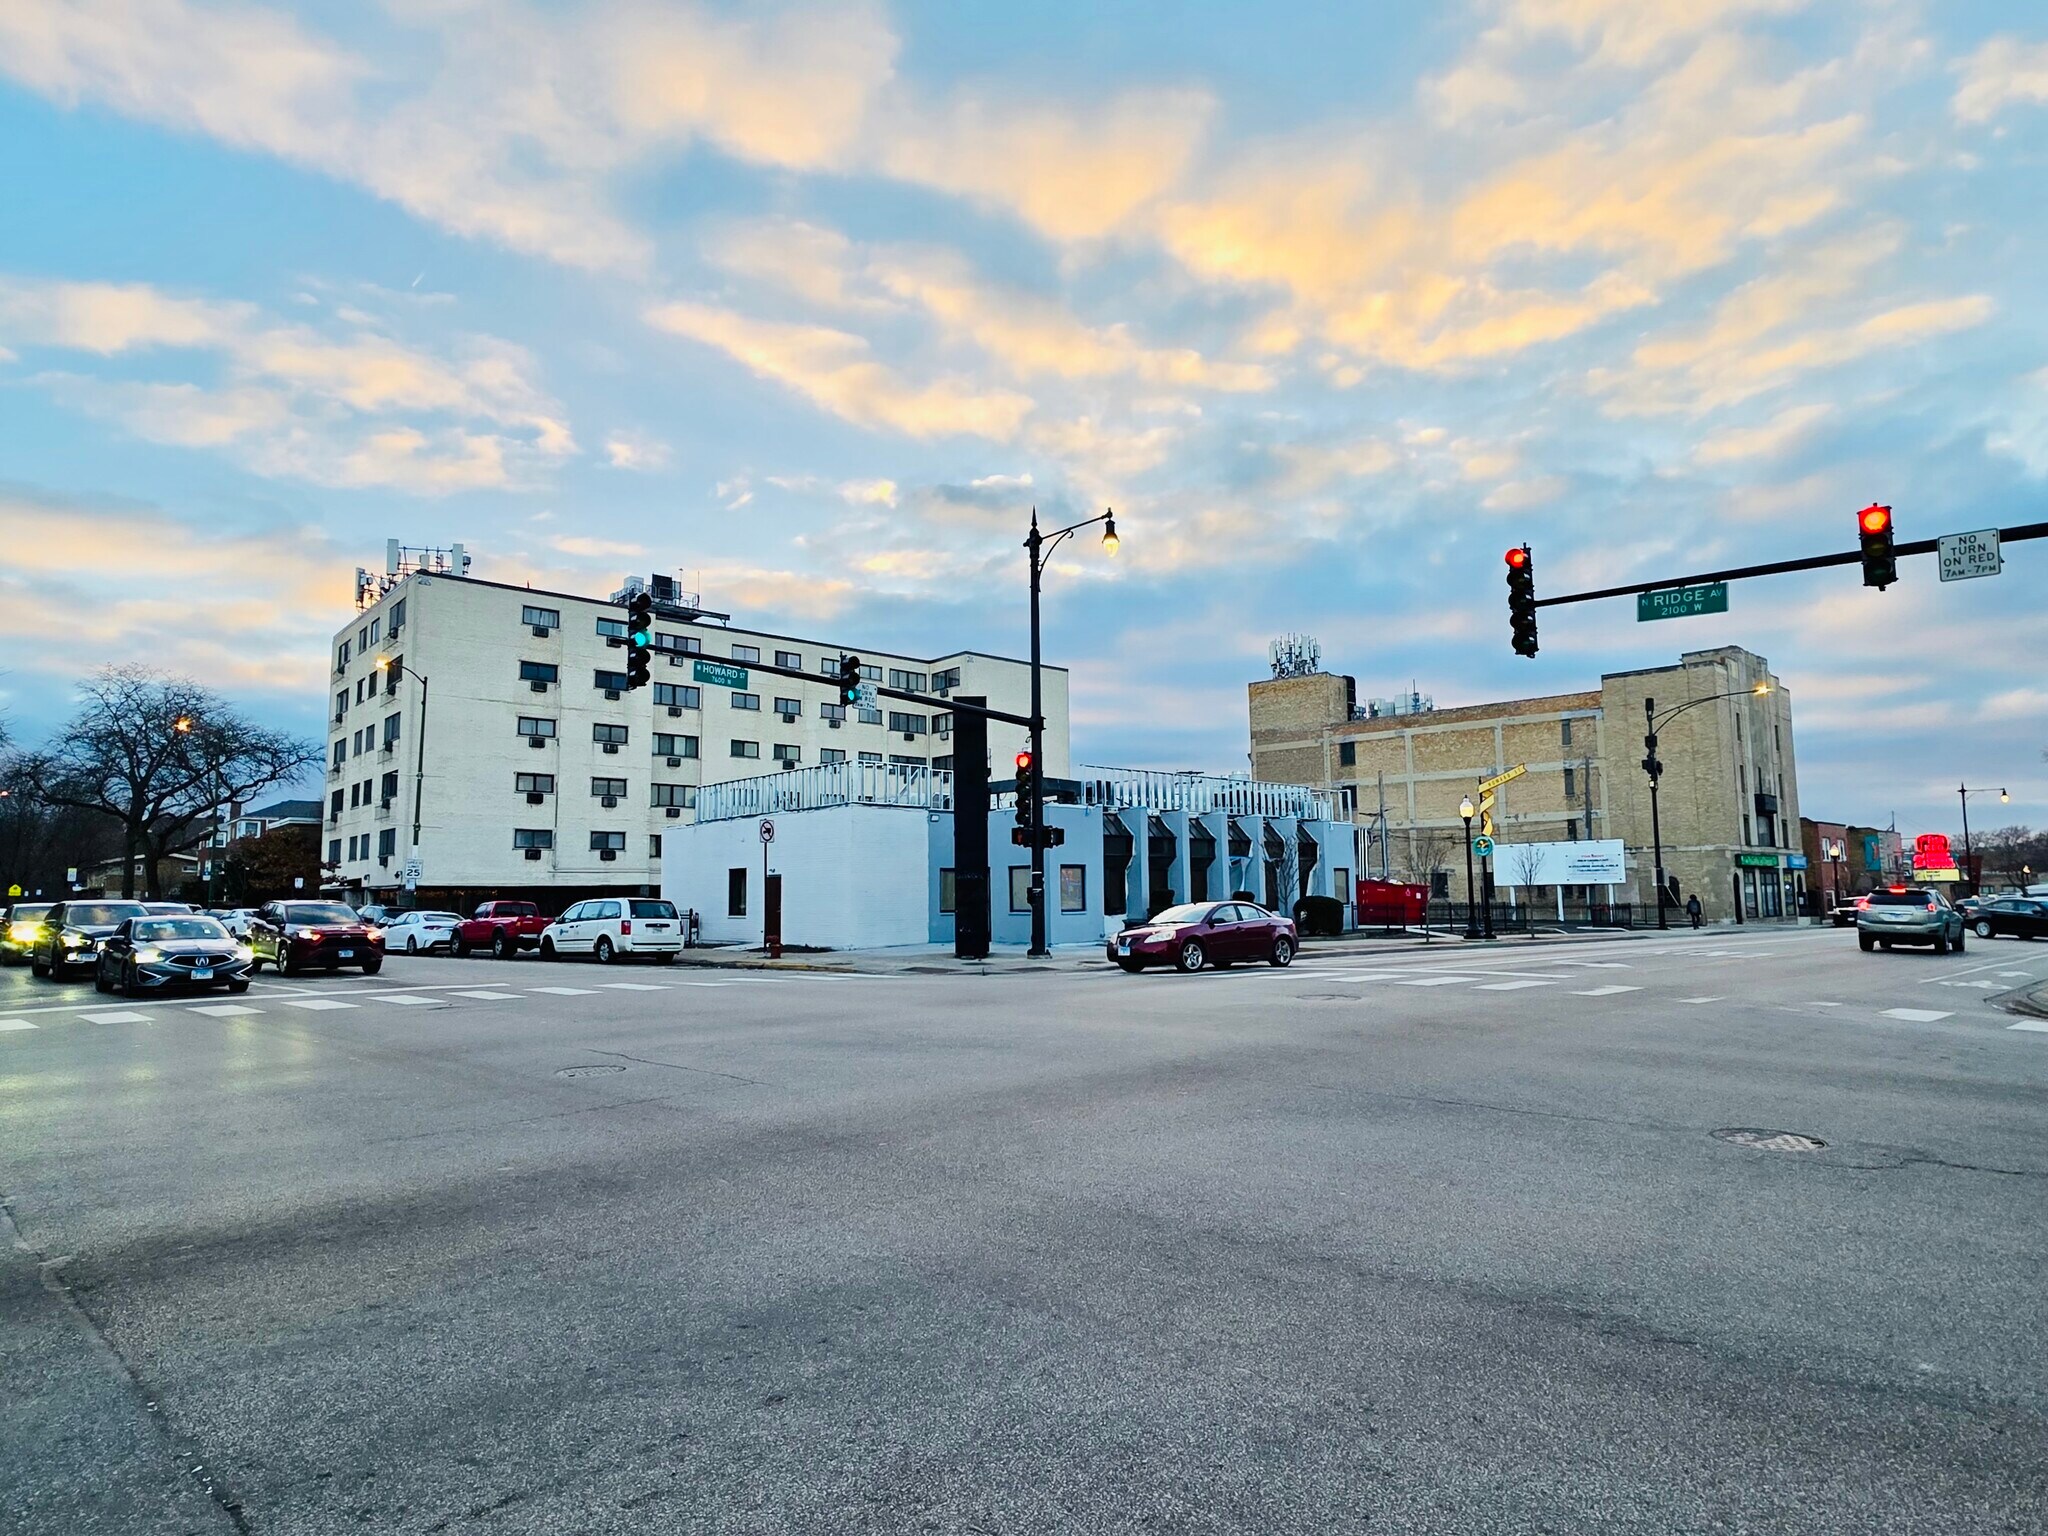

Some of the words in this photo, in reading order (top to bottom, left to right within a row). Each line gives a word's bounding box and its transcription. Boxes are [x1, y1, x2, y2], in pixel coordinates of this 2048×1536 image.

[1958, 535, 1977, 546] NO
[1950, 543, 1986, 556] TURN
[1943, 557, 1962, 567] ON
[1968, 552, 1995, 564] RED
[1653, 590, 1705, 606] RIDGE
[1710, 589, 1723, 598] AV
[1661, 605, 1687, 616] 2100
[1694, 603, 1702, 611] W
[702, 664, 738, 679] HOWARD
[406, 868, 420, 877] 25
